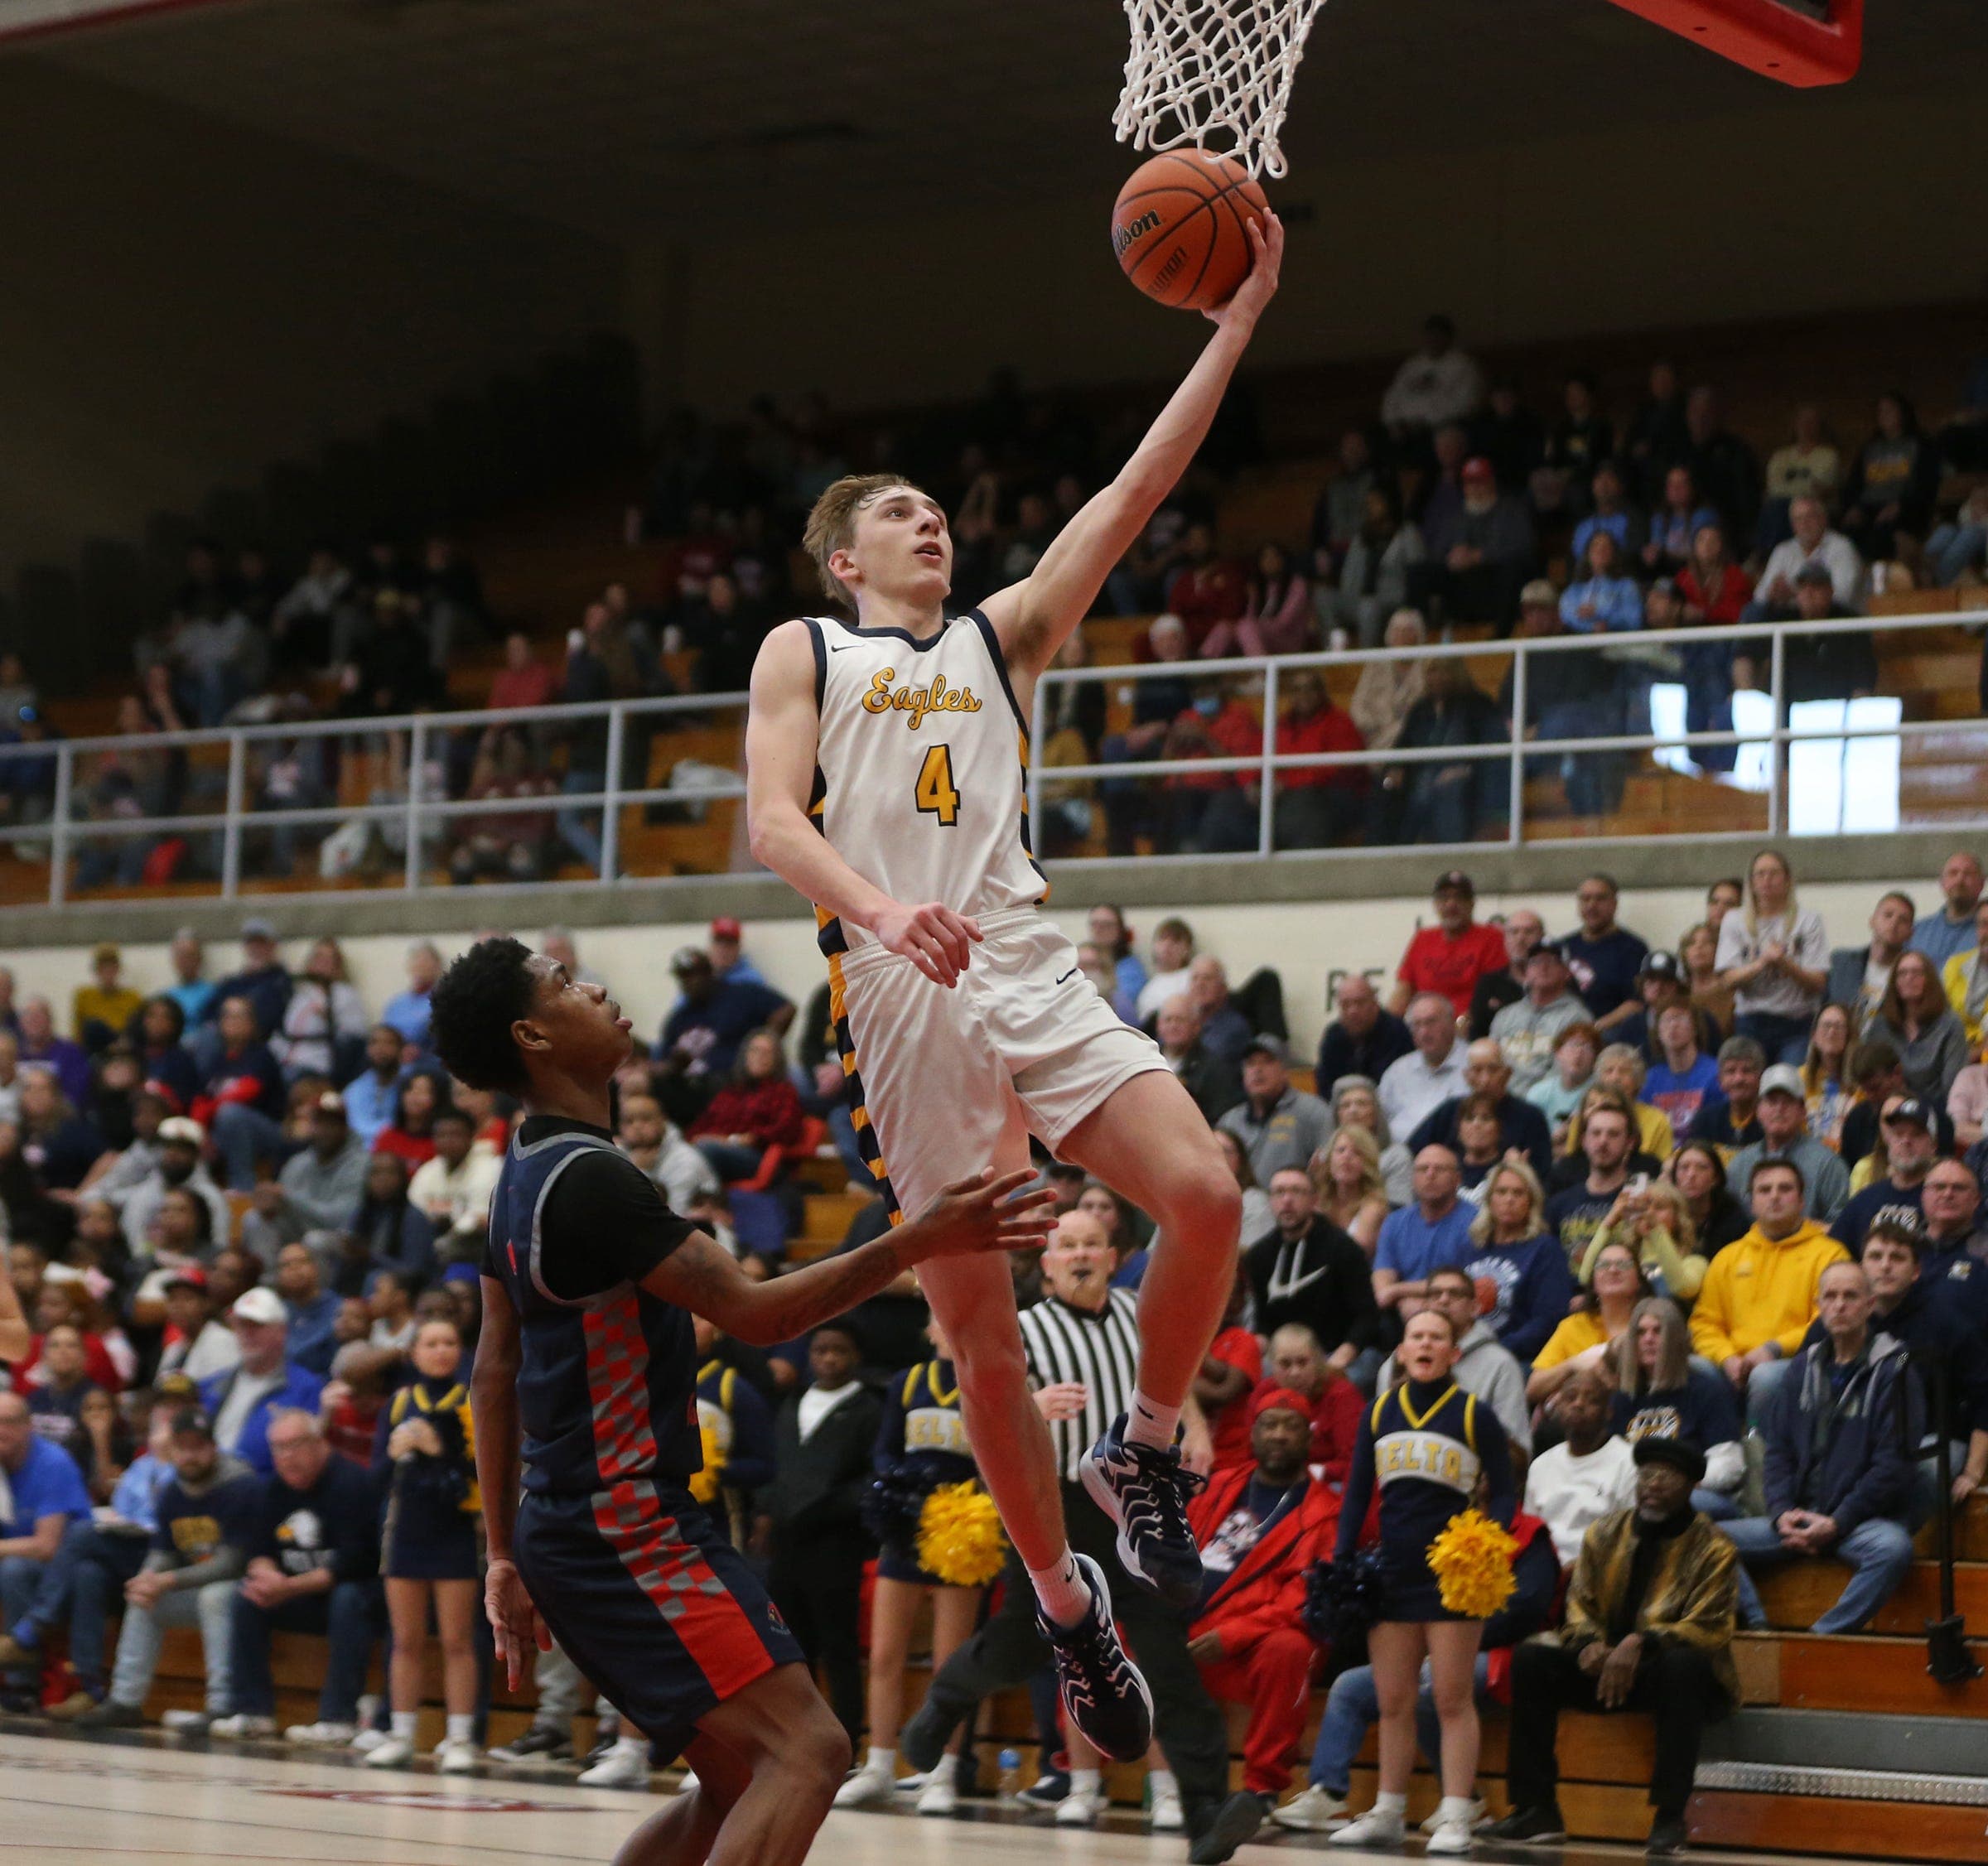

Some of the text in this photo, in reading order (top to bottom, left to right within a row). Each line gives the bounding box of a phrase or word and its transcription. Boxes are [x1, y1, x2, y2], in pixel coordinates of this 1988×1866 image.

[862, 667, 982, 730] Eagles
[914, 744, 961, 827] 4
[905, 1415, 963, 1446] ELT
